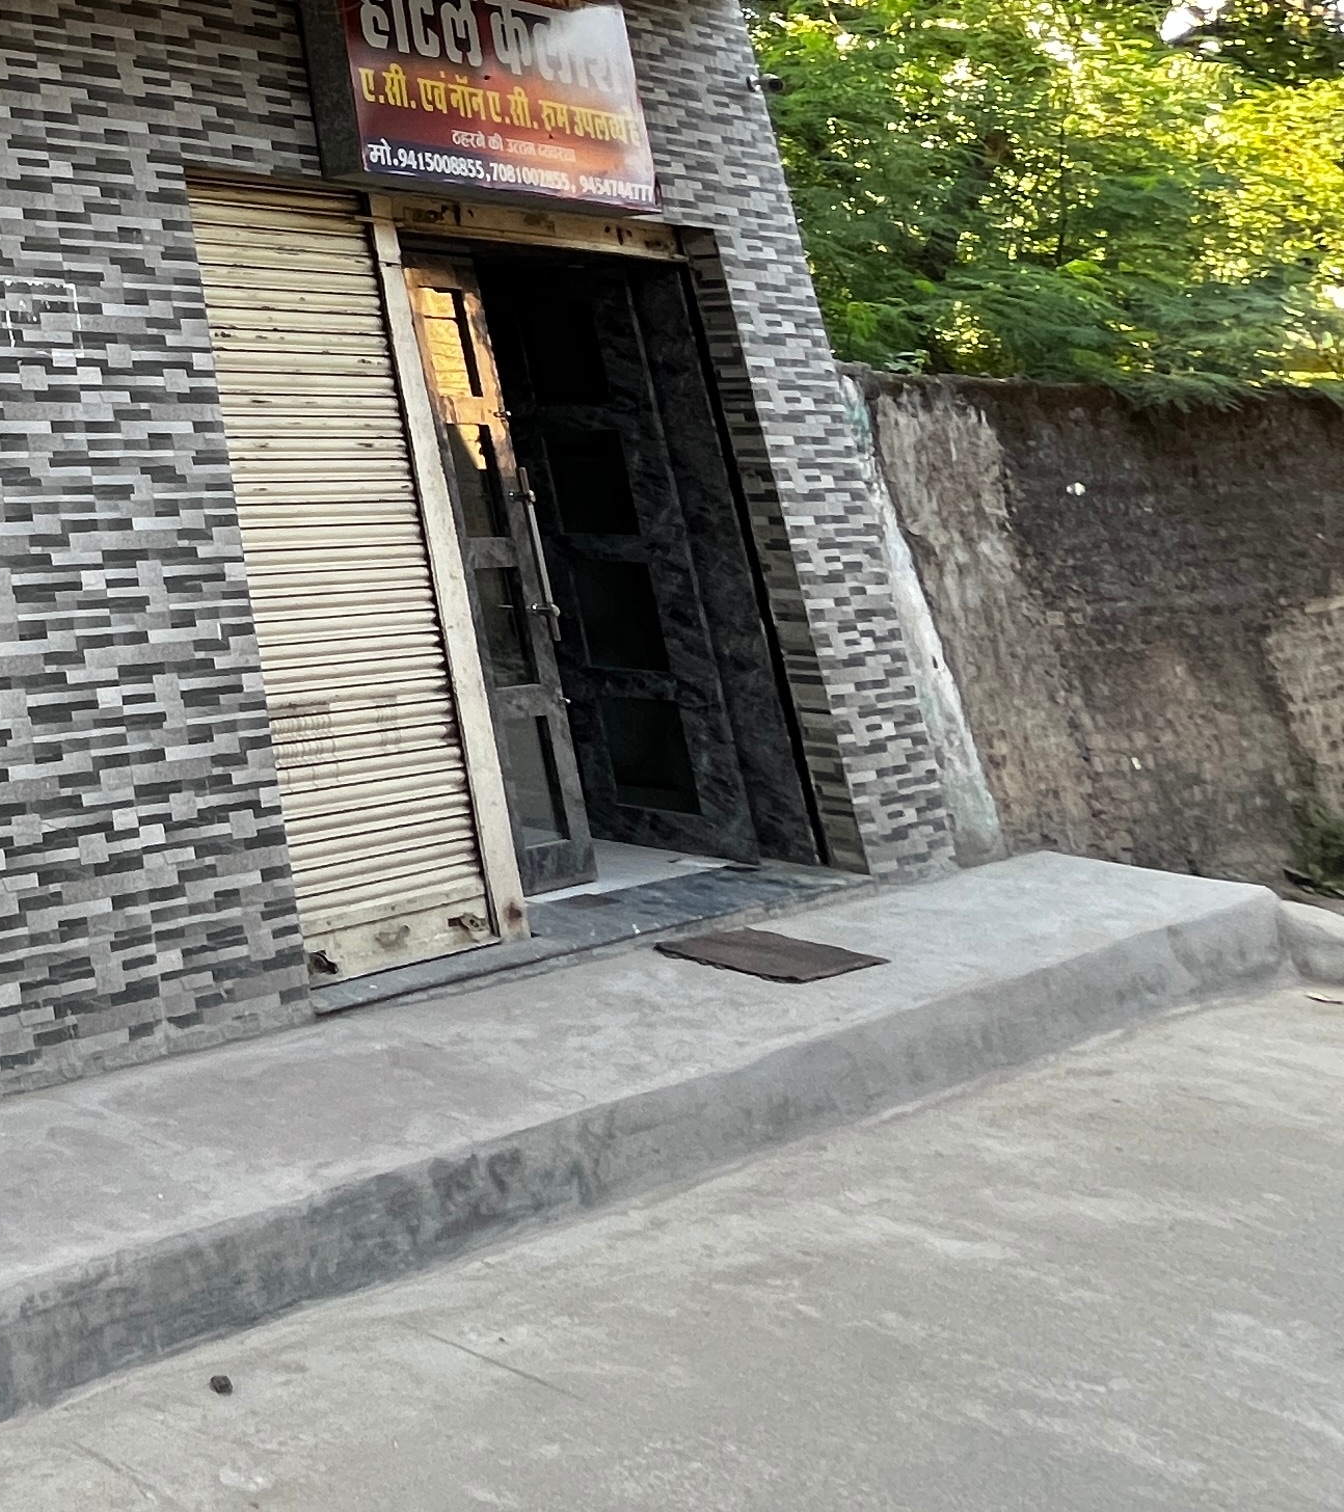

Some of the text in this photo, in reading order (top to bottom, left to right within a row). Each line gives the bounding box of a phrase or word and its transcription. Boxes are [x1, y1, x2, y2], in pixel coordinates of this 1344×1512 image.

[417, 71, 448, 115] एवं
[448, 74, 487, 122] नॉन
[487, 132, 504, 152] की
